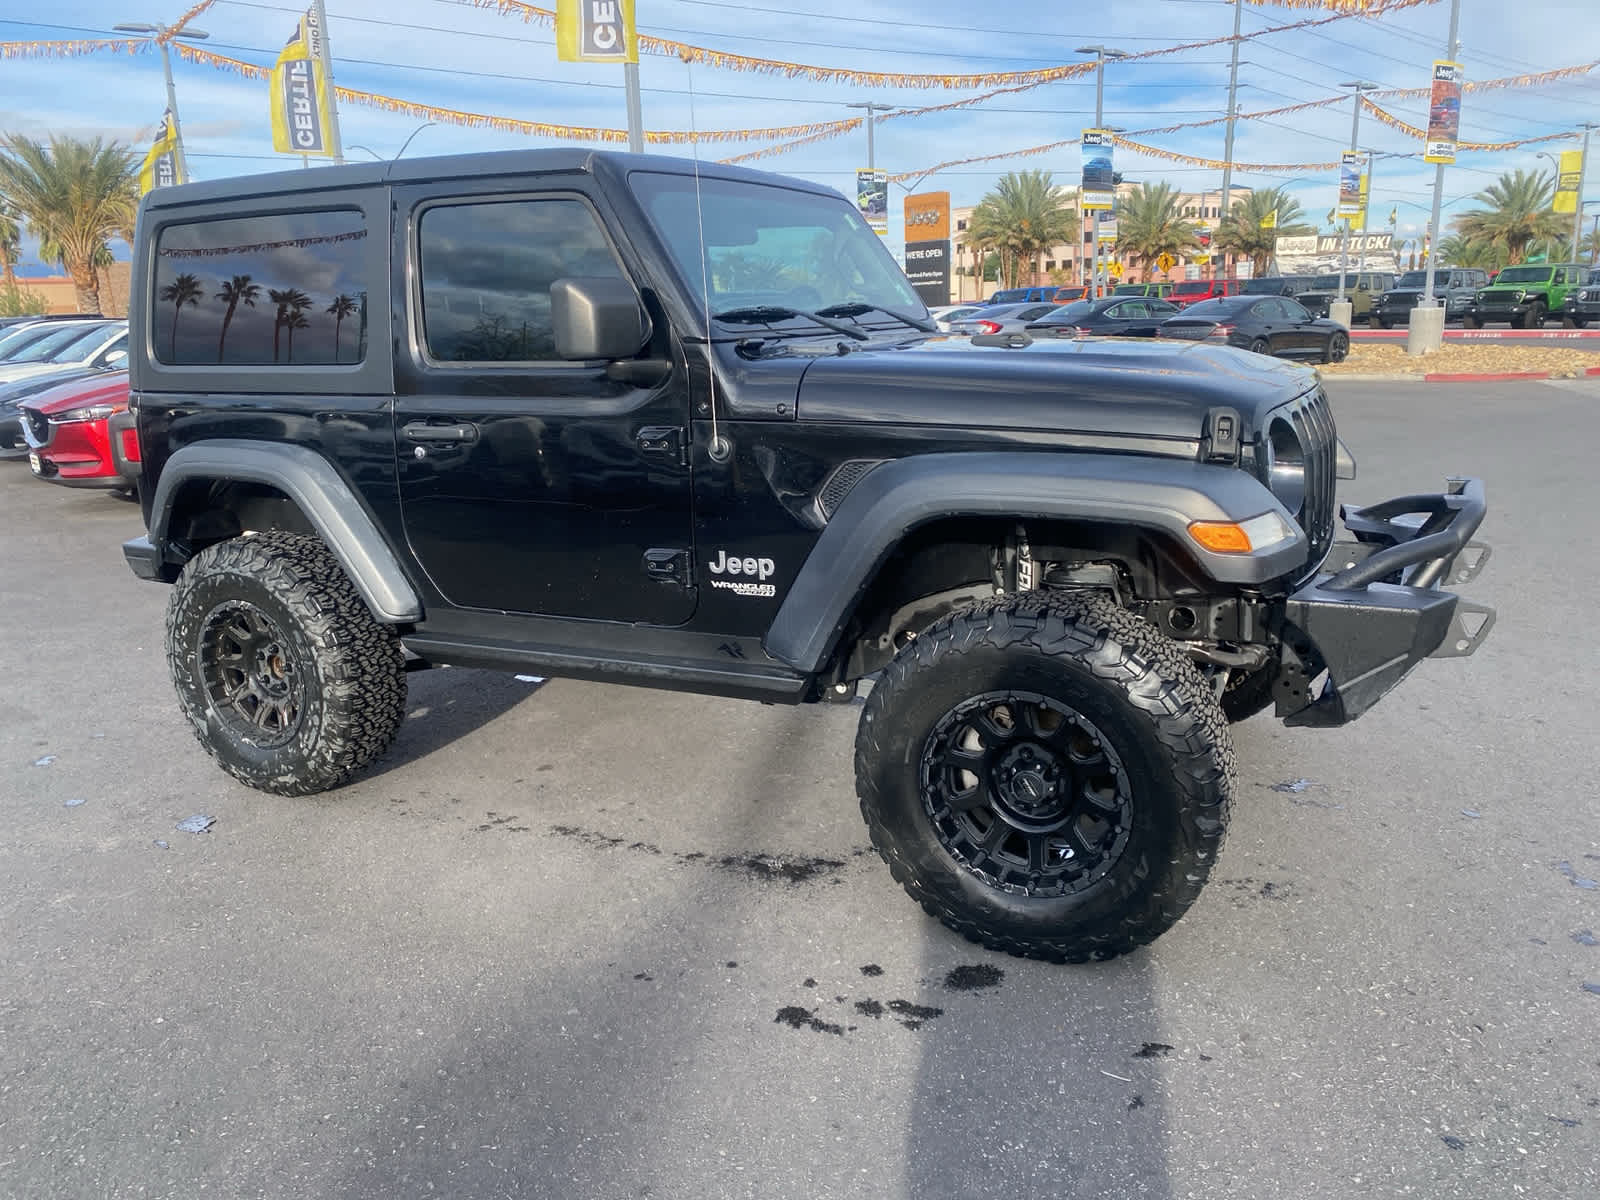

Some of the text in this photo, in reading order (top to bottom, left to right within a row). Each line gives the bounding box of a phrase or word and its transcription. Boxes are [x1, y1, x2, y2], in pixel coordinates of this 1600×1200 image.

[1085, 134, 1101, 144] Jeep
[905, 208, 940, 227] Jeep
[1277, 239, 1316, 253] Jeep
[1321, 238, 1337, 251] IN
[925, 248, 943, 258] OPEN
[708, 550, 775, 581] Jeep
[710, 580, 776, 593] WRANGLER
